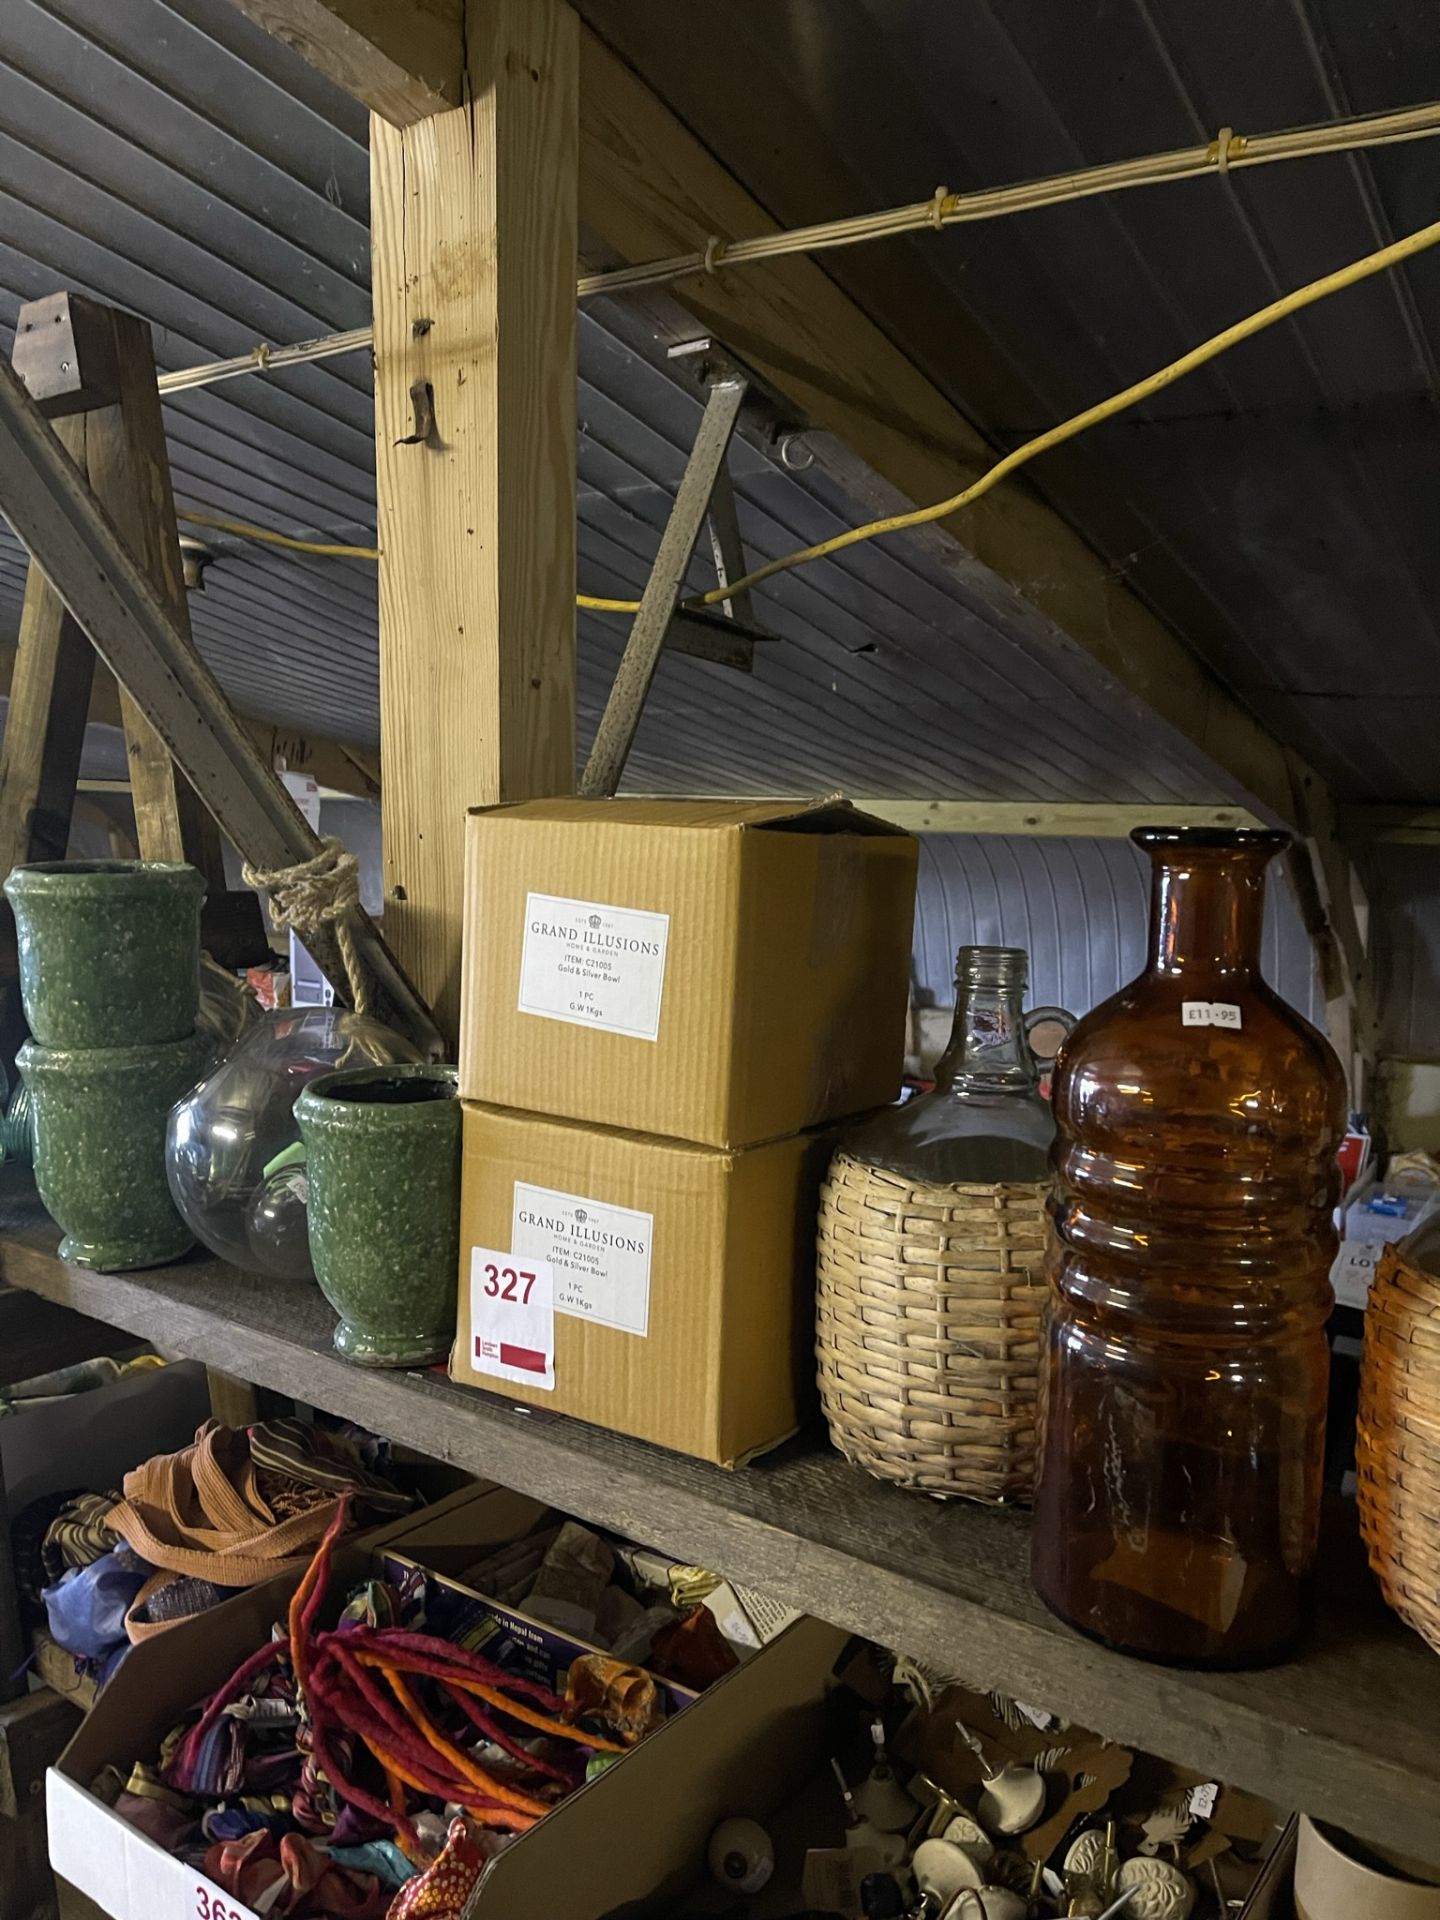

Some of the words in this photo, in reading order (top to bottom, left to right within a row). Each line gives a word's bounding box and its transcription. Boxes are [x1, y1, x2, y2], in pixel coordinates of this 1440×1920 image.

[531, 921, 578, 941] GRAND
[583, 930, 660, 956] ILLUSIONS
[558, 963, 574, 974] Gold
[576, 967, 581, 975] &
[582, 968, 602, 980] Silver
[603, 972, 621, 983] Bowl
[584, 991, 594, 1001] PC
[586, 1005, 603, 1018] 1Kgs
[518, 1210, 565, 1233] GRAND
[570, 1223, 645, 1255] ILLUSIONS
[546, 1254, 563, 1266] Gold
[564, 1259, 569, 1267] &
[570, 1260, 589, 1272] Silver
[590, 1265, 608, 1278] Bowl
[573, 1251, 599, 1266] C21005
[1350, 1256, 1375, 1268] LO
[483, 1263, 537, 1305] 327
[573, 1283, 583, 1293] PC
[576, 1297, 593, 1310] 1Kgs
[502, 1617, 509, 1628] in
[509, 1620, 528, 1637] Nepal
[528, 1629, 544, 1645] from
